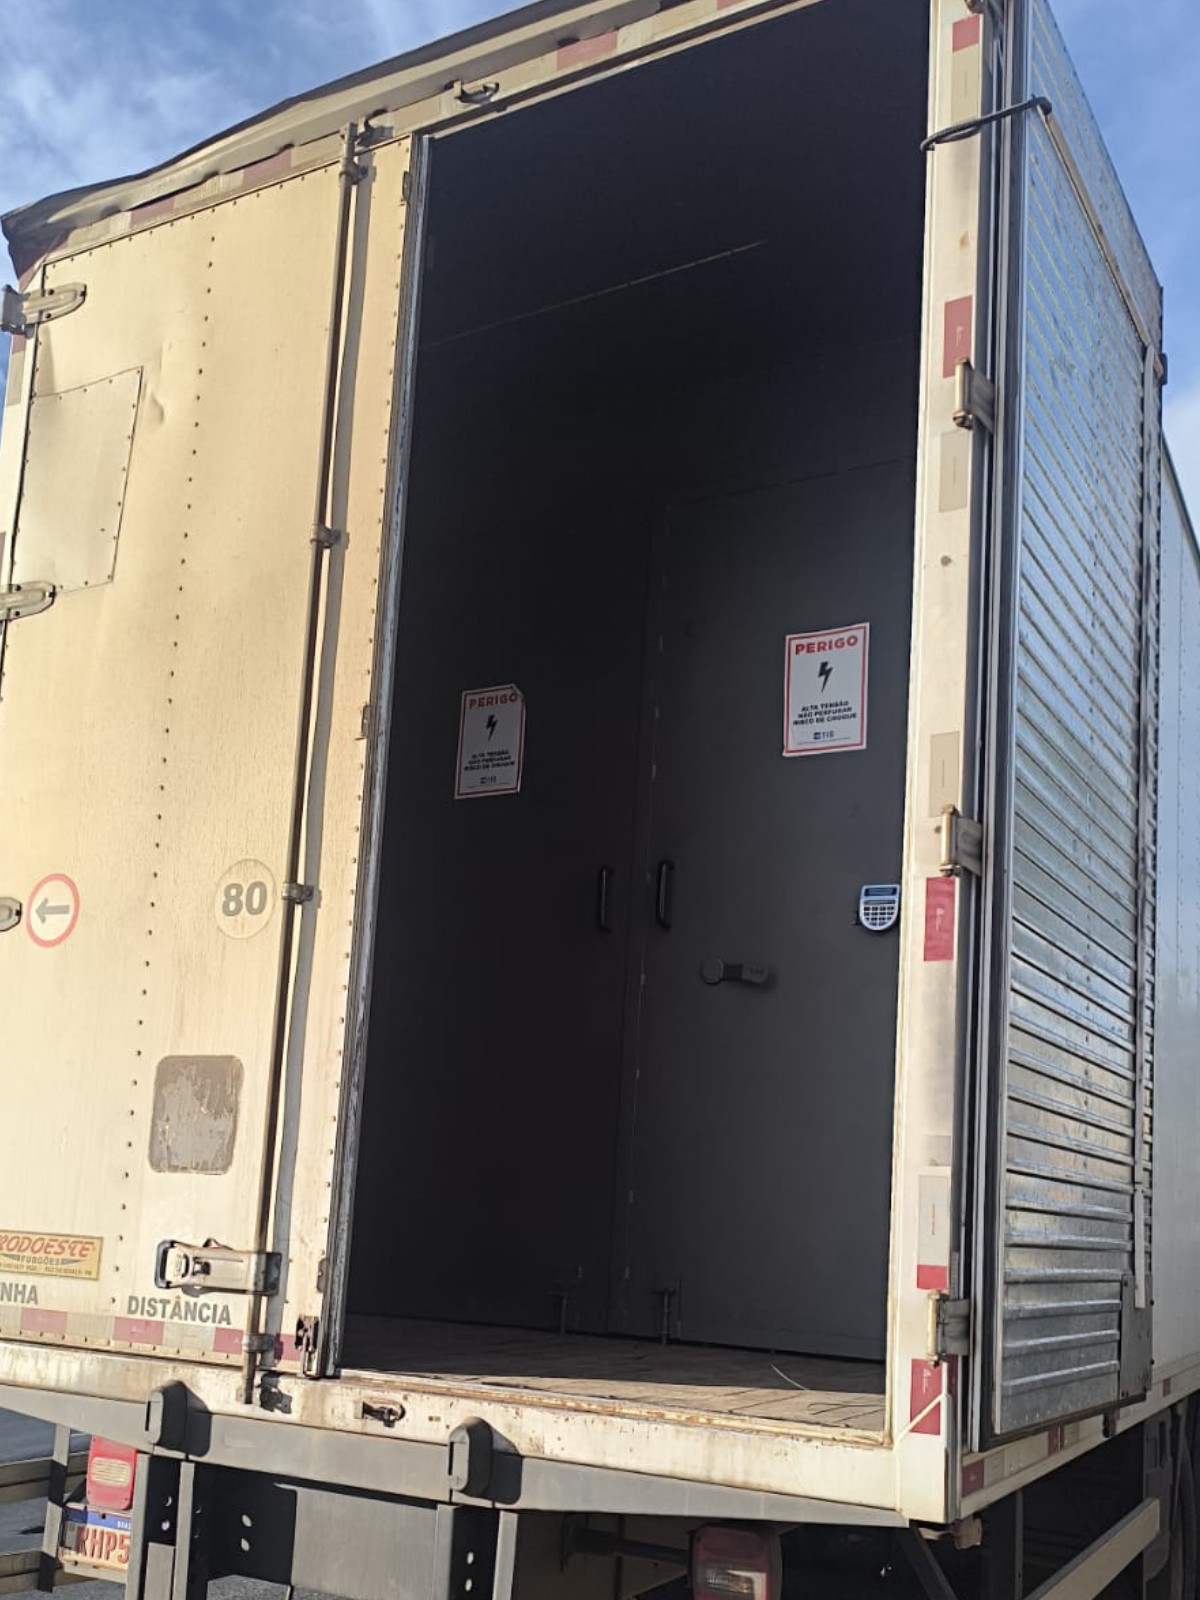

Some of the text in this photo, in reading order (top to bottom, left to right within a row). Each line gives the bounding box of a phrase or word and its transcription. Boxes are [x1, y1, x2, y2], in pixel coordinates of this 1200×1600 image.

[795, 636, 859, 656] PERIGO
[469, 693, 518, 709] PERIGO
[222, 881, 267, 917] 80
[127, 1295, 232, 1326] DISTÂNCIA
